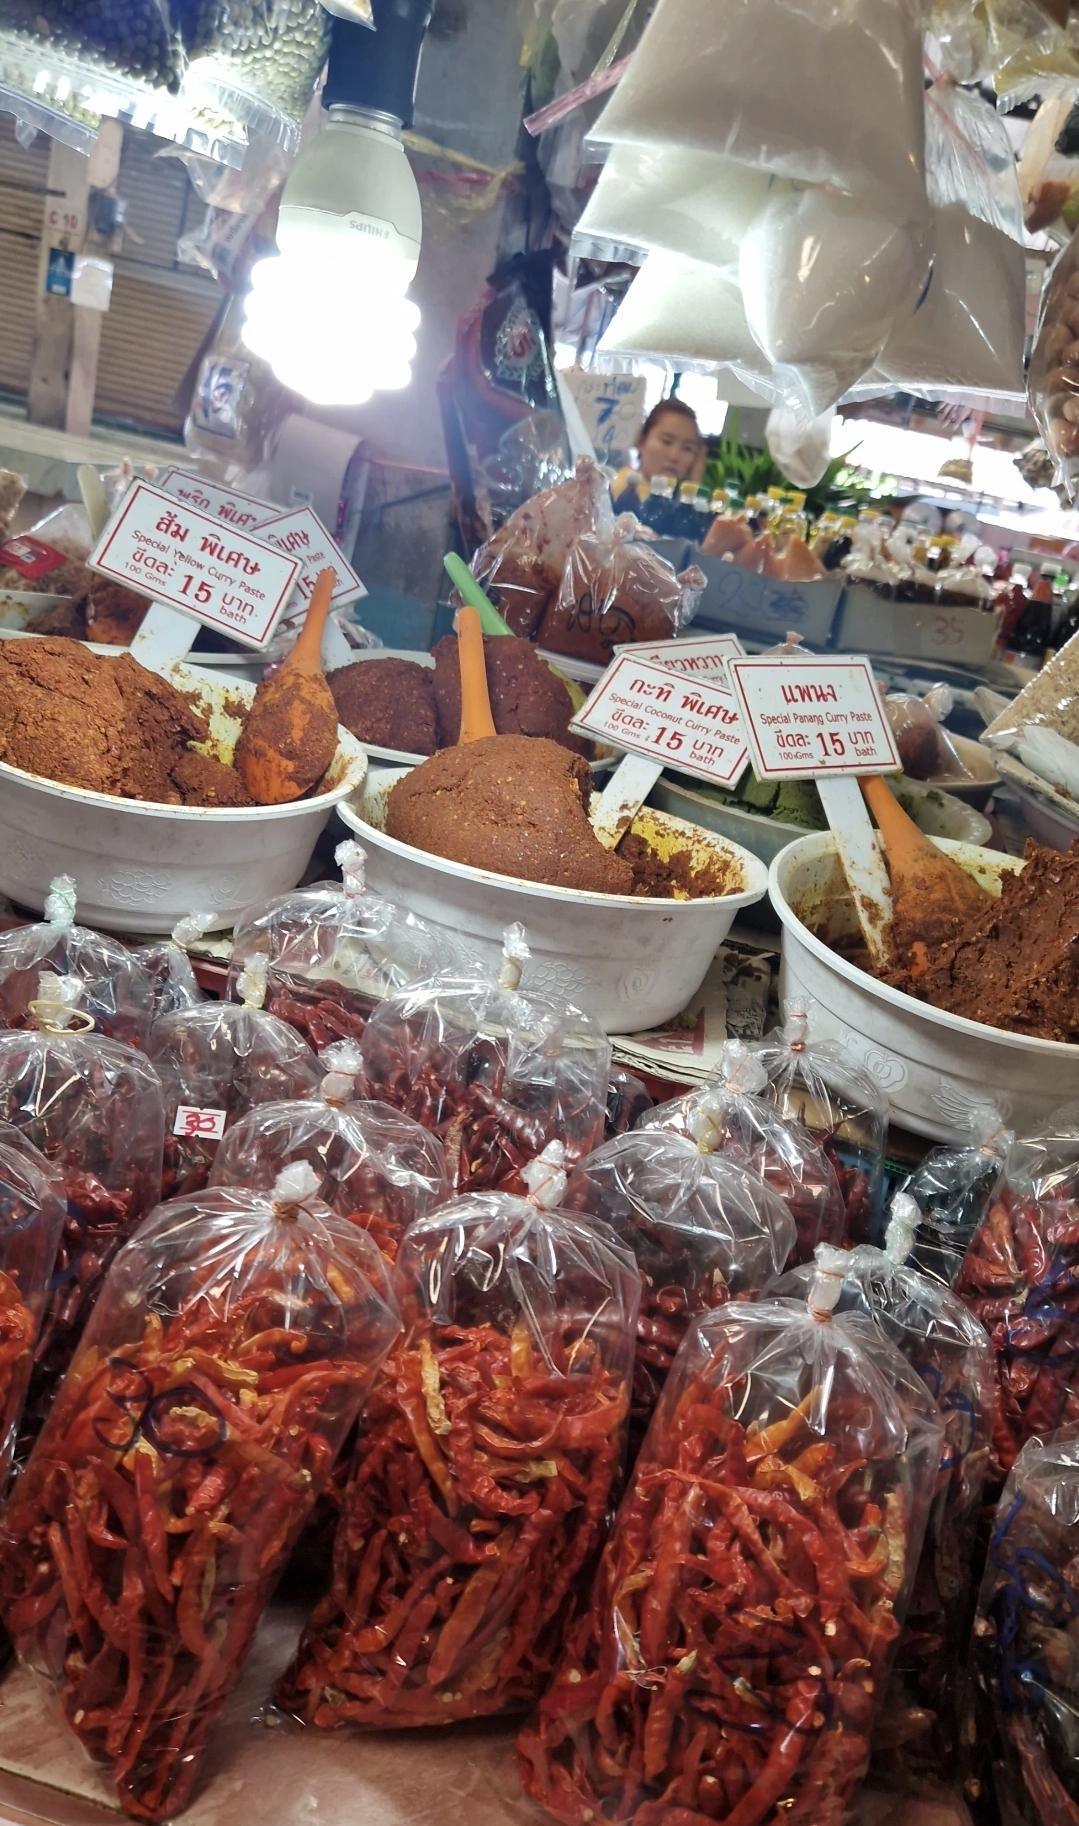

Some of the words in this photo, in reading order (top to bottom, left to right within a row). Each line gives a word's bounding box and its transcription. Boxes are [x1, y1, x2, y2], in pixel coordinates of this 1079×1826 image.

[349, 219, 391, 240] PHILIPS
[217, 502, 257, 526] พิเศ
[155, 511, 190, 542] ส้ม
[199, 533, 261, 575] พิเศษ
[124, 561, 142, 575] 100
[145, 571, 167, 587] Gms
[131, 530, 170, 554] Special
[173, 548, 205, 571] Yellow
[208, 567, 236, 586] Curry
[239, 581, 266, 601] Paste
[132, 547, 175, 577] ขีดละ
[178, 574, 216, 604] 15
[222, 592, 255, 617] บาท
[220, 605, 247, 625] bath
[932, 616, 965, 646] 35
[628, 678, 676, 703] กะทิ
[680, 692, 739, 725] พิเศษ
[780, 684, 839, 704] แพนง
[603, 721, 619, 732] 100
[621, 728, 641, 739] Gms
[608, 693, 643, 711] Special
[644, 705, 683, 725] Coconut
[685, 719, 712, 736] Curry
[714, 729, 741, 745] Paste
[760, 713, 791, 727] Special
[793, 713, 824, 726] Panang
[825, 712, 848, 726] Curry
[850, 711, 873, 722] Paste
[611, 707, 651, 732] ขีดละ
[650, 726, 687, 750] 15
[692, 739, 725, 758] บาท
[774, 729, 811, 748] ขีดละ
[816, 731, 846, 757] 15
[848, 731, 875, 745] บาท
[689, 750, 716, 766] bath
[779, 752, 794, 761] 100
[855, 747, 877, 757] bath
[185, 1112, 216, 1136] 30
[92, 1356, 228, 1458] 30
